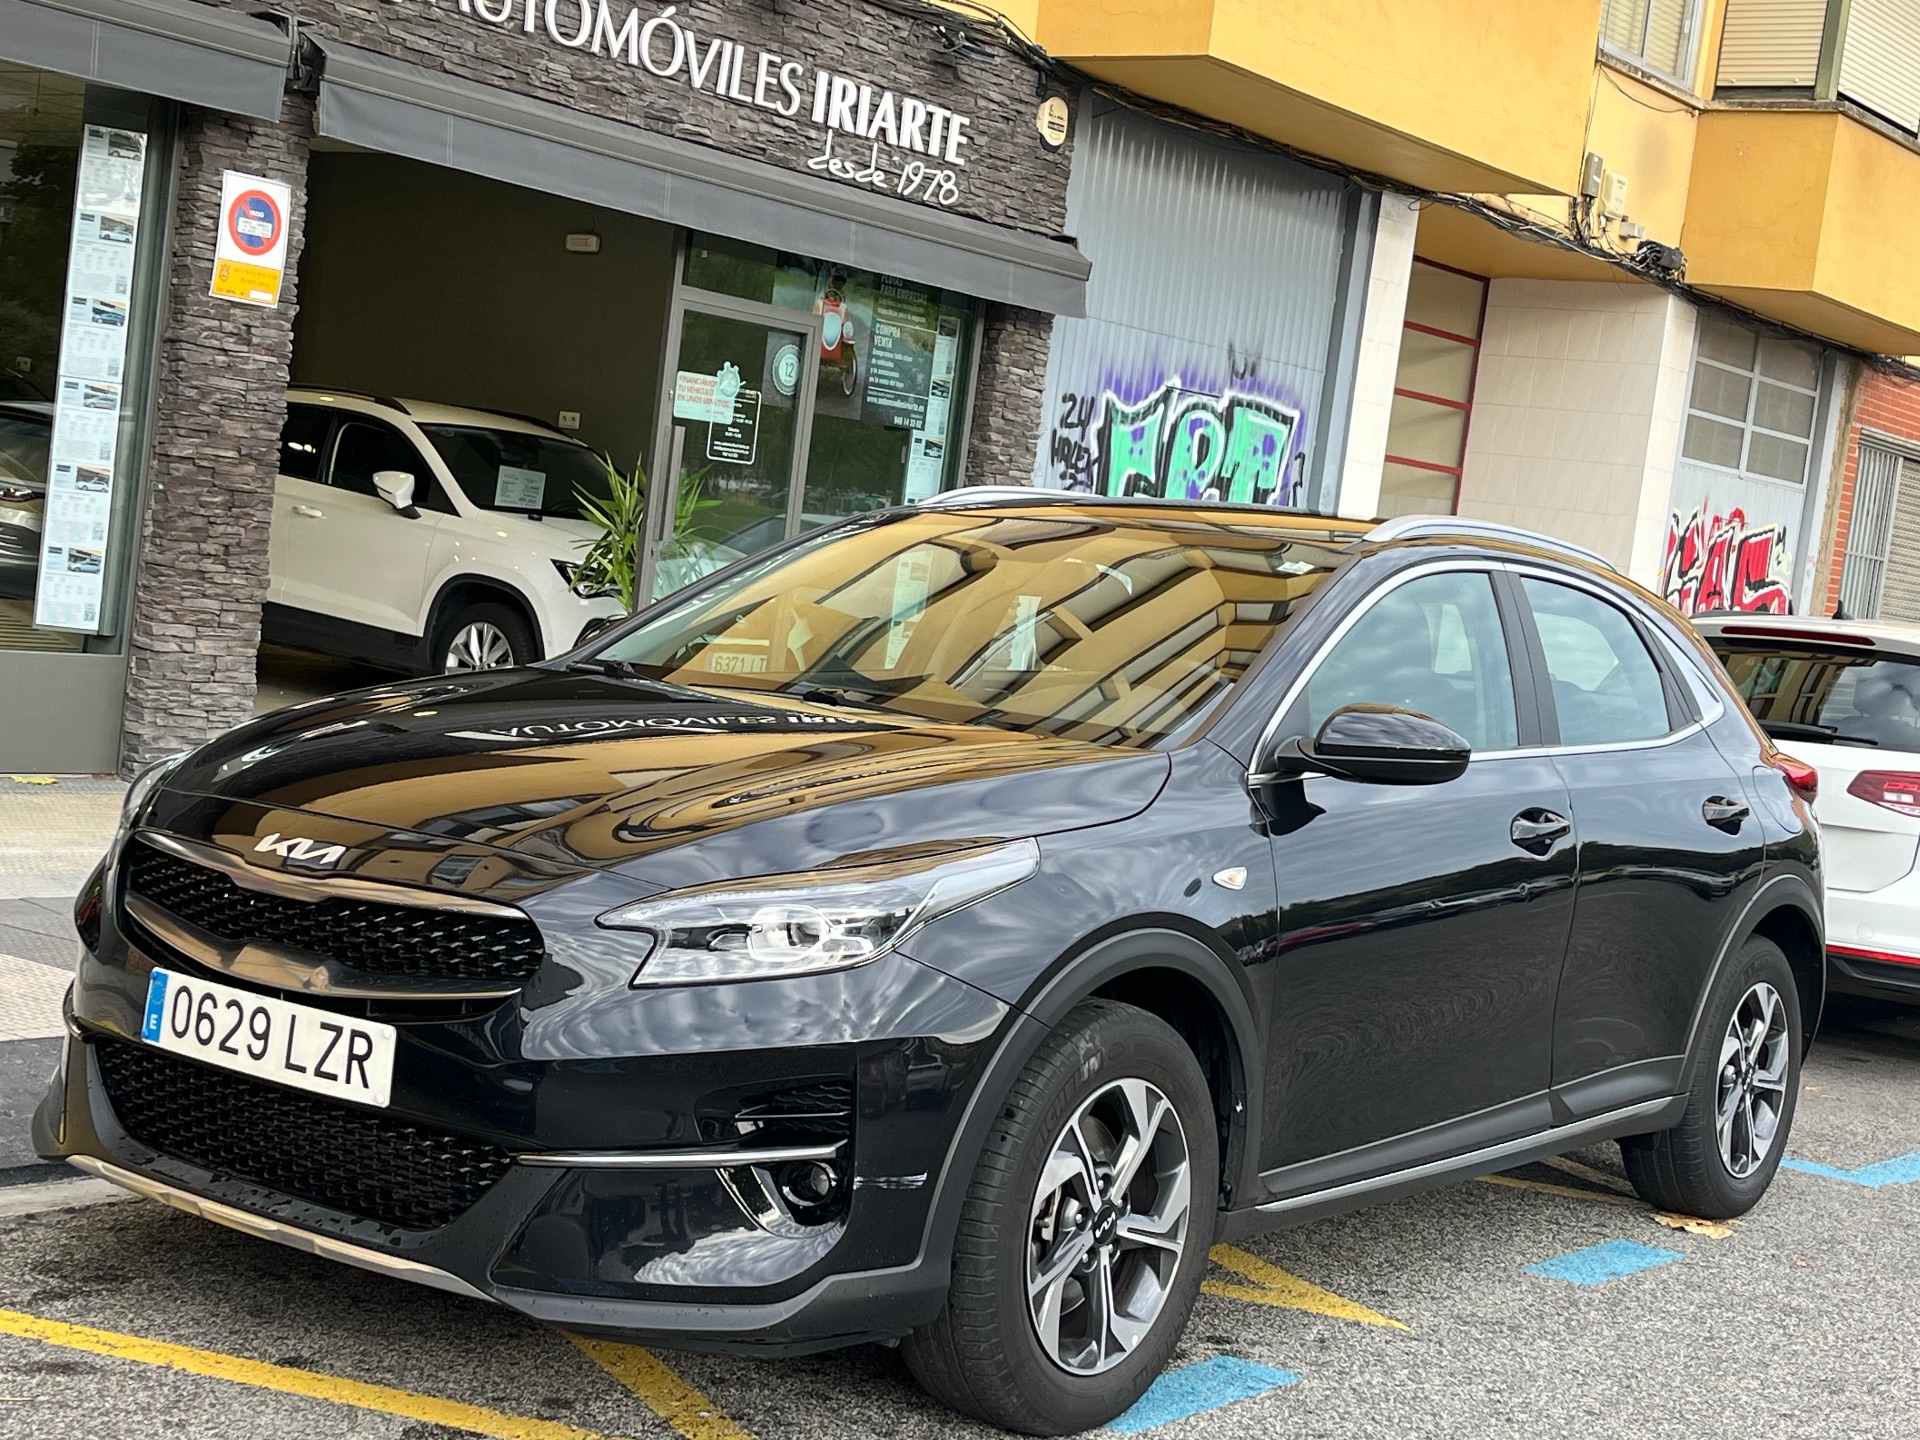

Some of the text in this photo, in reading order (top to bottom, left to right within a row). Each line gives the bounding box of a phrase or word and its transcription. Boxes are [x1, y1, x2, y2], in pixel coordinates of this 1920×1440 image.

[811, 71, 970, 166] IRIARTE
[807, 129, 959, 205] desde 1978
[873, 334, 893, 349] VENTA
[875, 323, 900, 338] COMPRA
[784, 361, 795, 379] 12
[254, 832, 347, 864] KIA
[149, 1013, 159, 1030] E
[170, 984, 375, 1089] 0629 LZR
